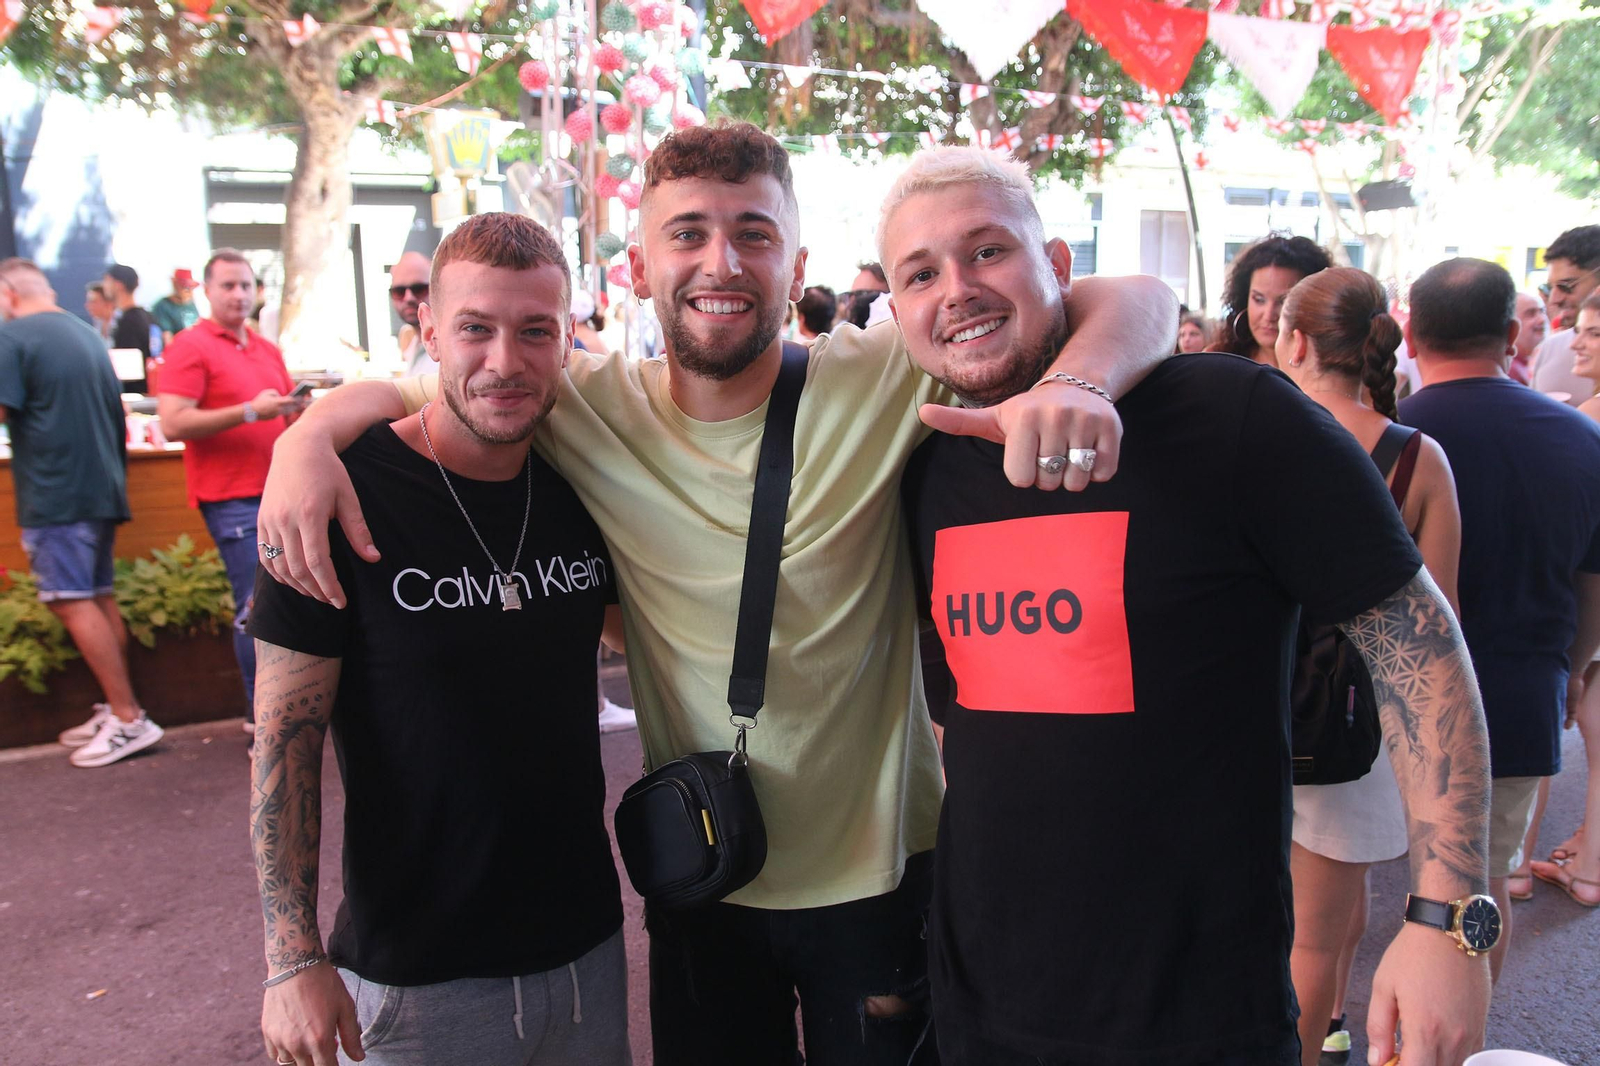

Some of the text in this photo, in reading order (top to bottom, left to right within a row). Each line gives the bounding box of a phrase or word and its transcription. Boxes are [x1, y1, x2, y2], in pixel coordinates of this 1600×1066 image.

[392, 550, 607, 612] Calvin Klein
[946, 588, 1083, 637] HUGO
